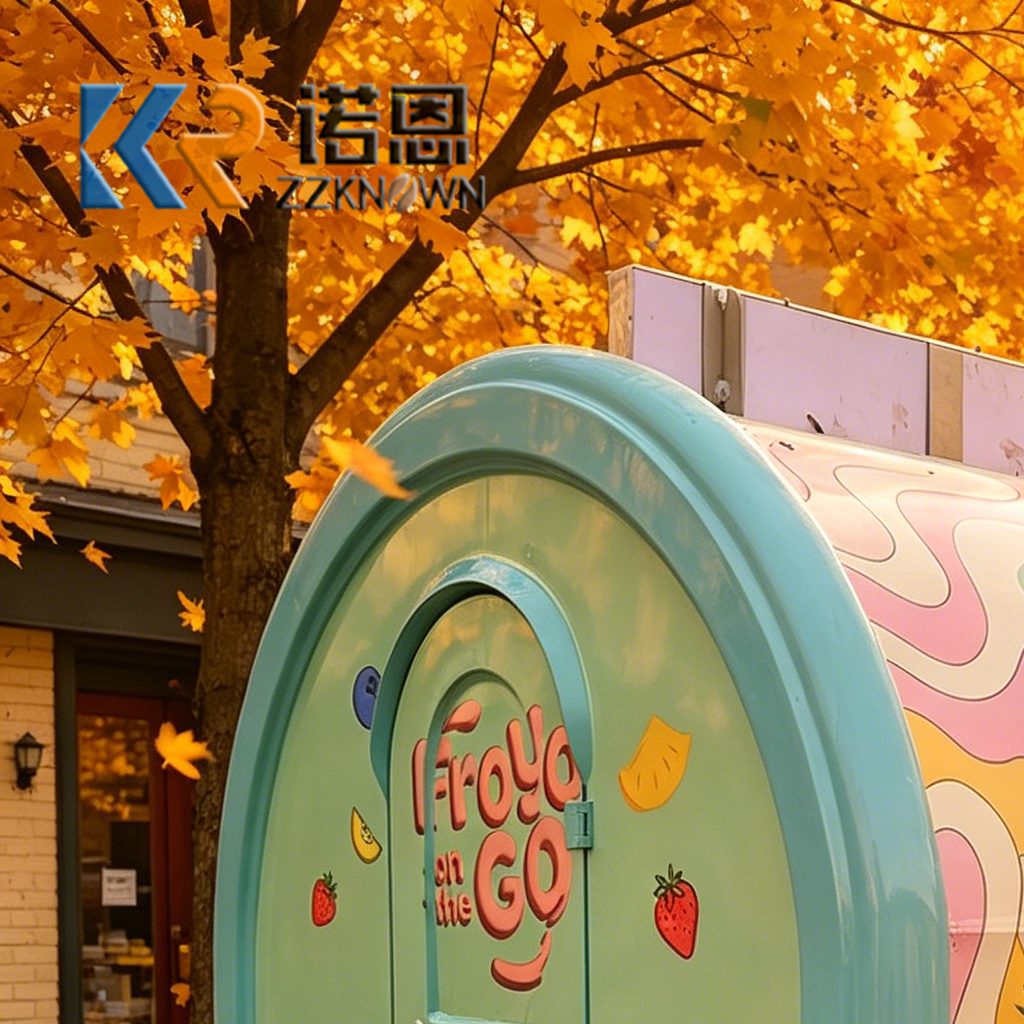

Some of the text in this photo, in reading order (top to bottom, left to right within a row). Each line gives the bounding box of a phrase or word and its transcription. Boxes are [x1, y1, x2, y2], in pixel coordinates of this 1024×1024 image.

[434, 851, 464, 886] on
[473, 816, 572, 941] GO
[434, 888, 473, 928] the
